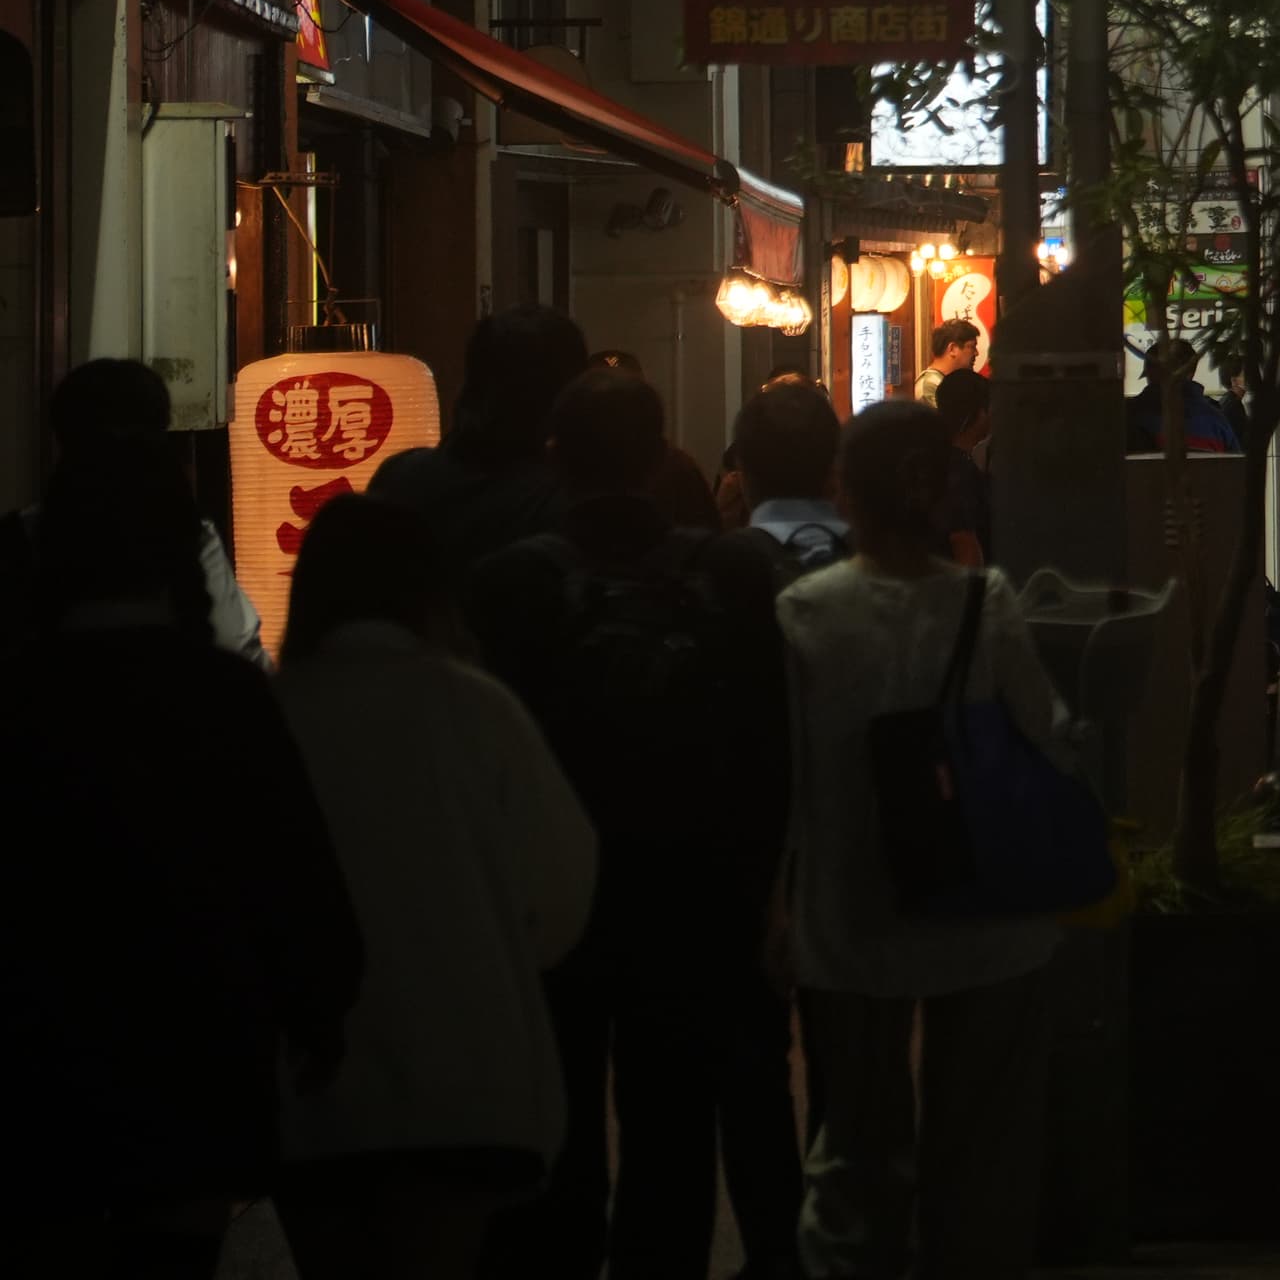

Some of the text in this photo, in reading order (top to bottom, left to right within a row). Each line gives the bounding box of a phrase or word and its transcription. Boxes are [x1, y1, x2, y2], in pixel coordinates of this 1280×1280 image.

[708, 6, 949, 45] 錦通り商店街
[268, 380, 379, 461] 濃厚
